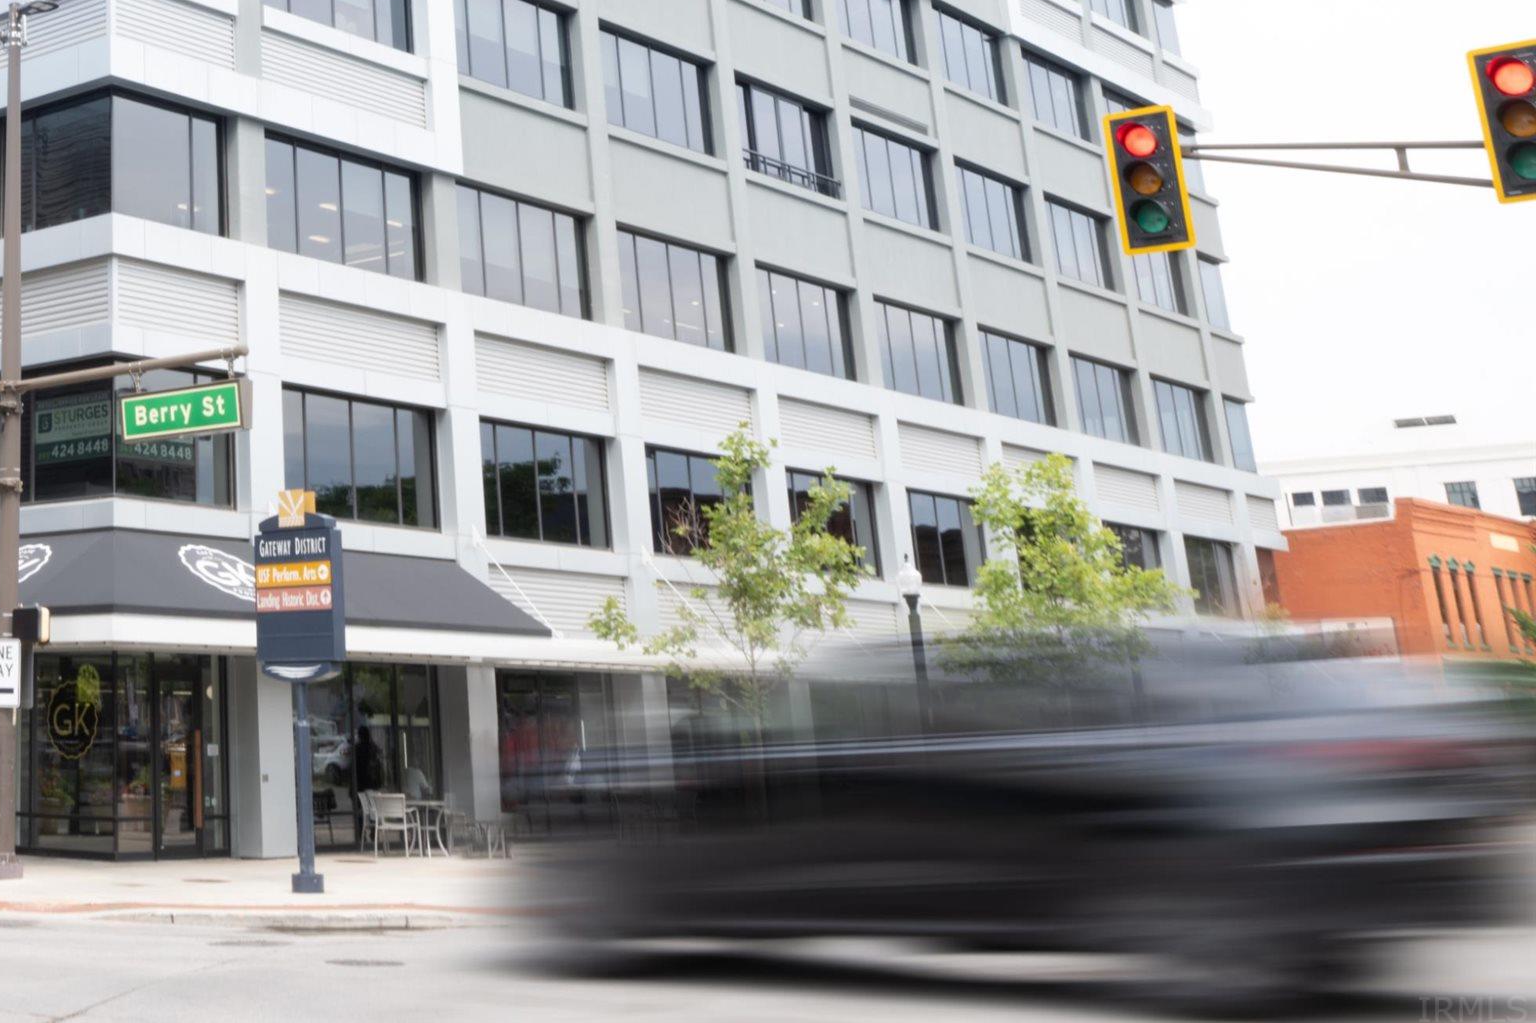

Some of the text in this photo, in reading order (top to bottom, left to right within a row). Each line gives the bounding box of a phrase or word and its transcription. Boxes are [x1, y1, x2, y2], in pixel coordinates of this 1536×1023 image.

[54, 404, 109, 425] STURGES
[134, 402, 192, 426] Berry
[202, 395, 225, 417] St
[51, 441, 74, 458] 424
[134, 441, 158, 457] 424
[161, 443, 192, 460] 8448
[259, 536, 326, 558] GATEWAY DISTRICT
[53, 702, 90, 736] GK
